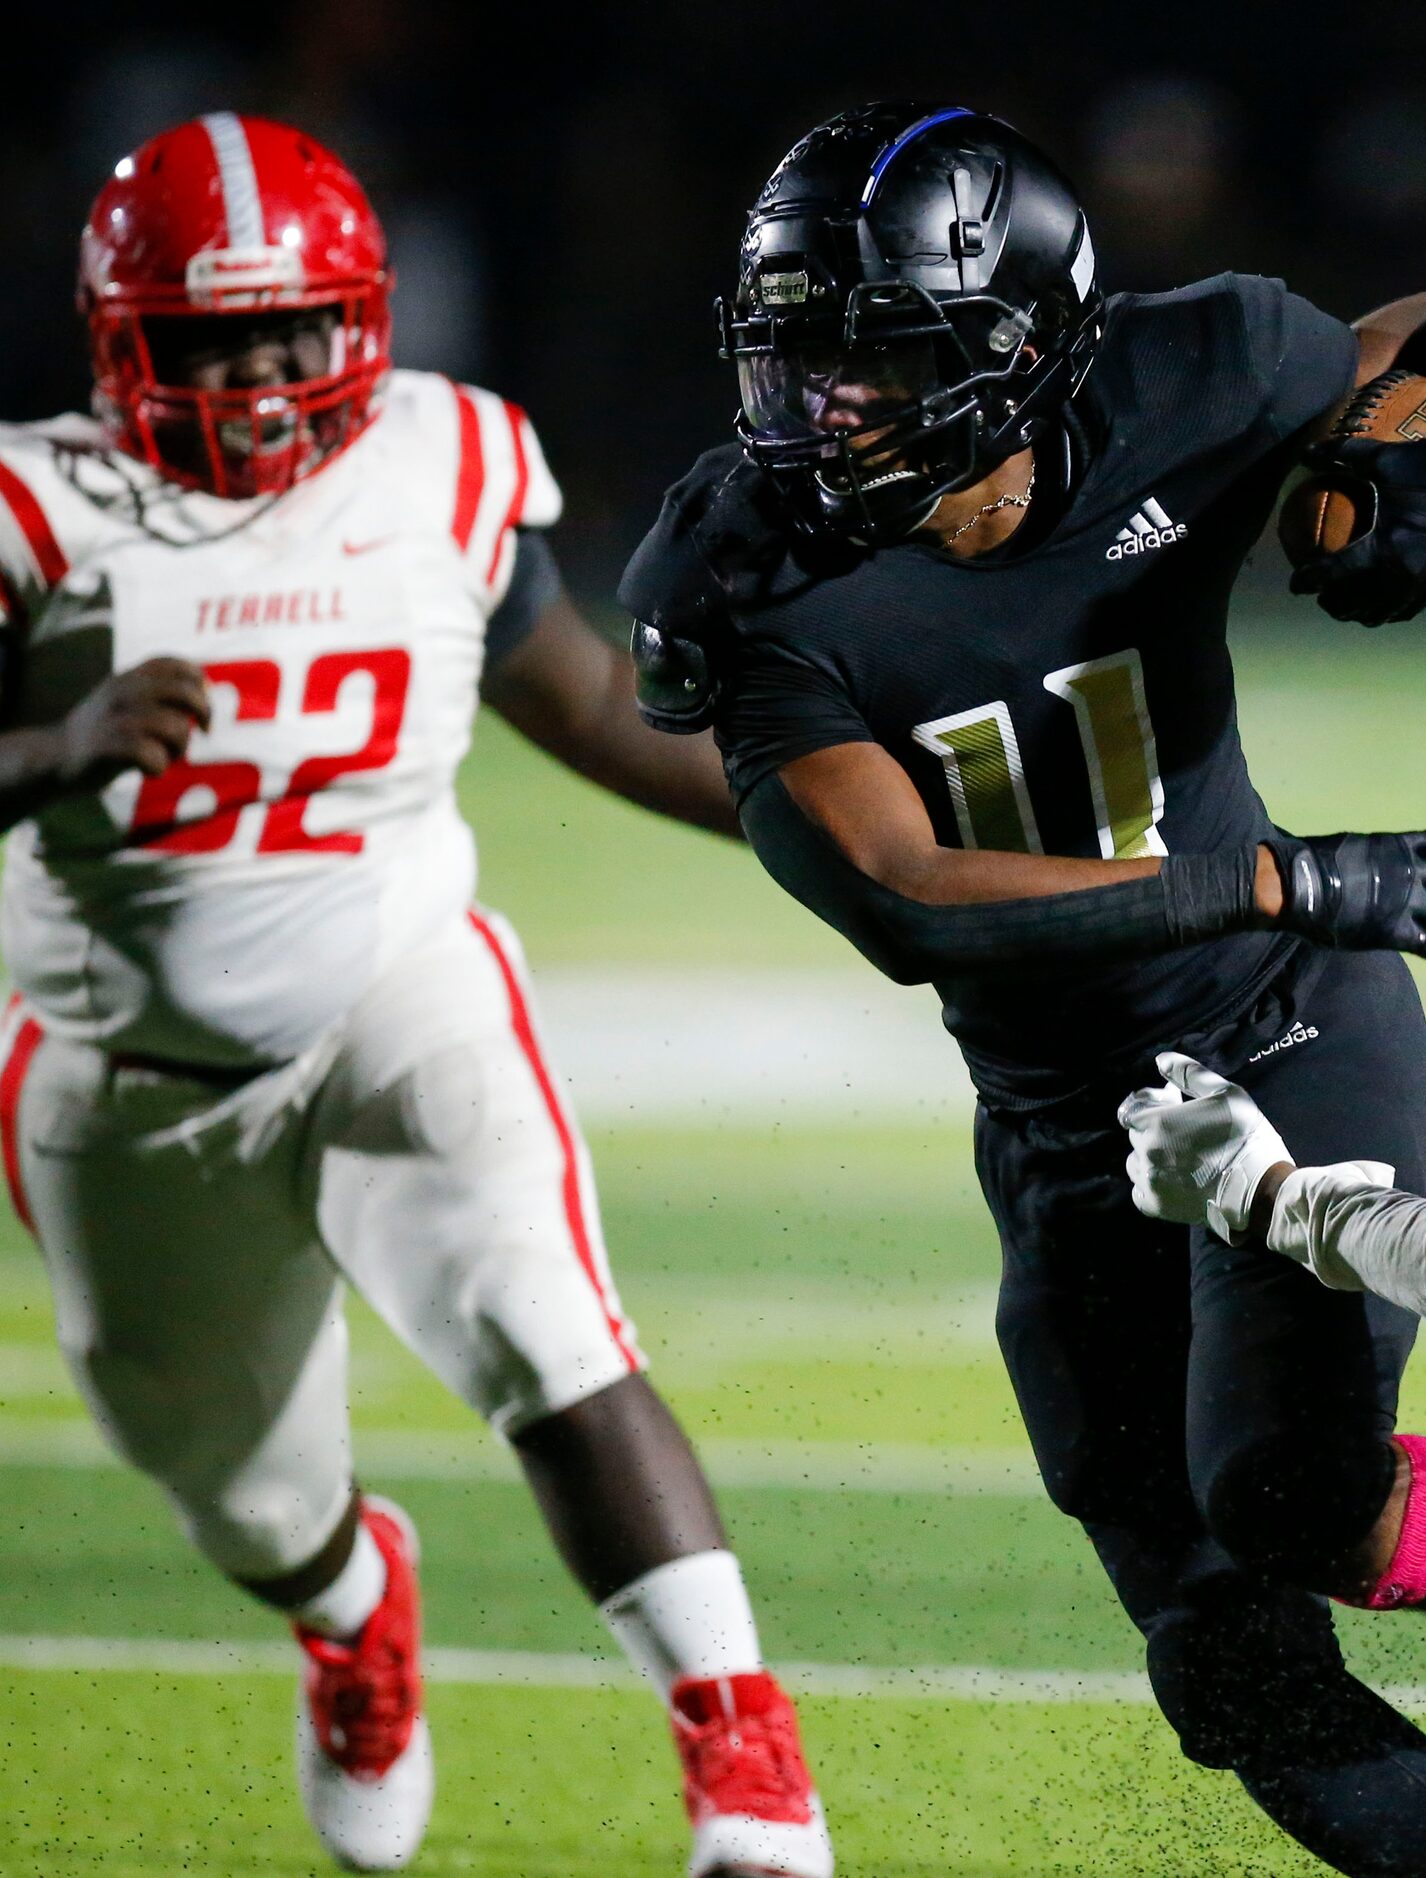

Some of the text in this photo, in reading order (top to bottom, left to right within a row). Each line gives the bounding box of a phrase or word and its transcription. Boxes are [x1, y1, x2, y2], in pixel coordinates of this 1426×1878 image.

[1106, 523, 1188, 560] adidas
[196, 587, 346, 634] TERRELL
[126, 646, 411, 857] 62
[911, 648, 1169, 860] 11
